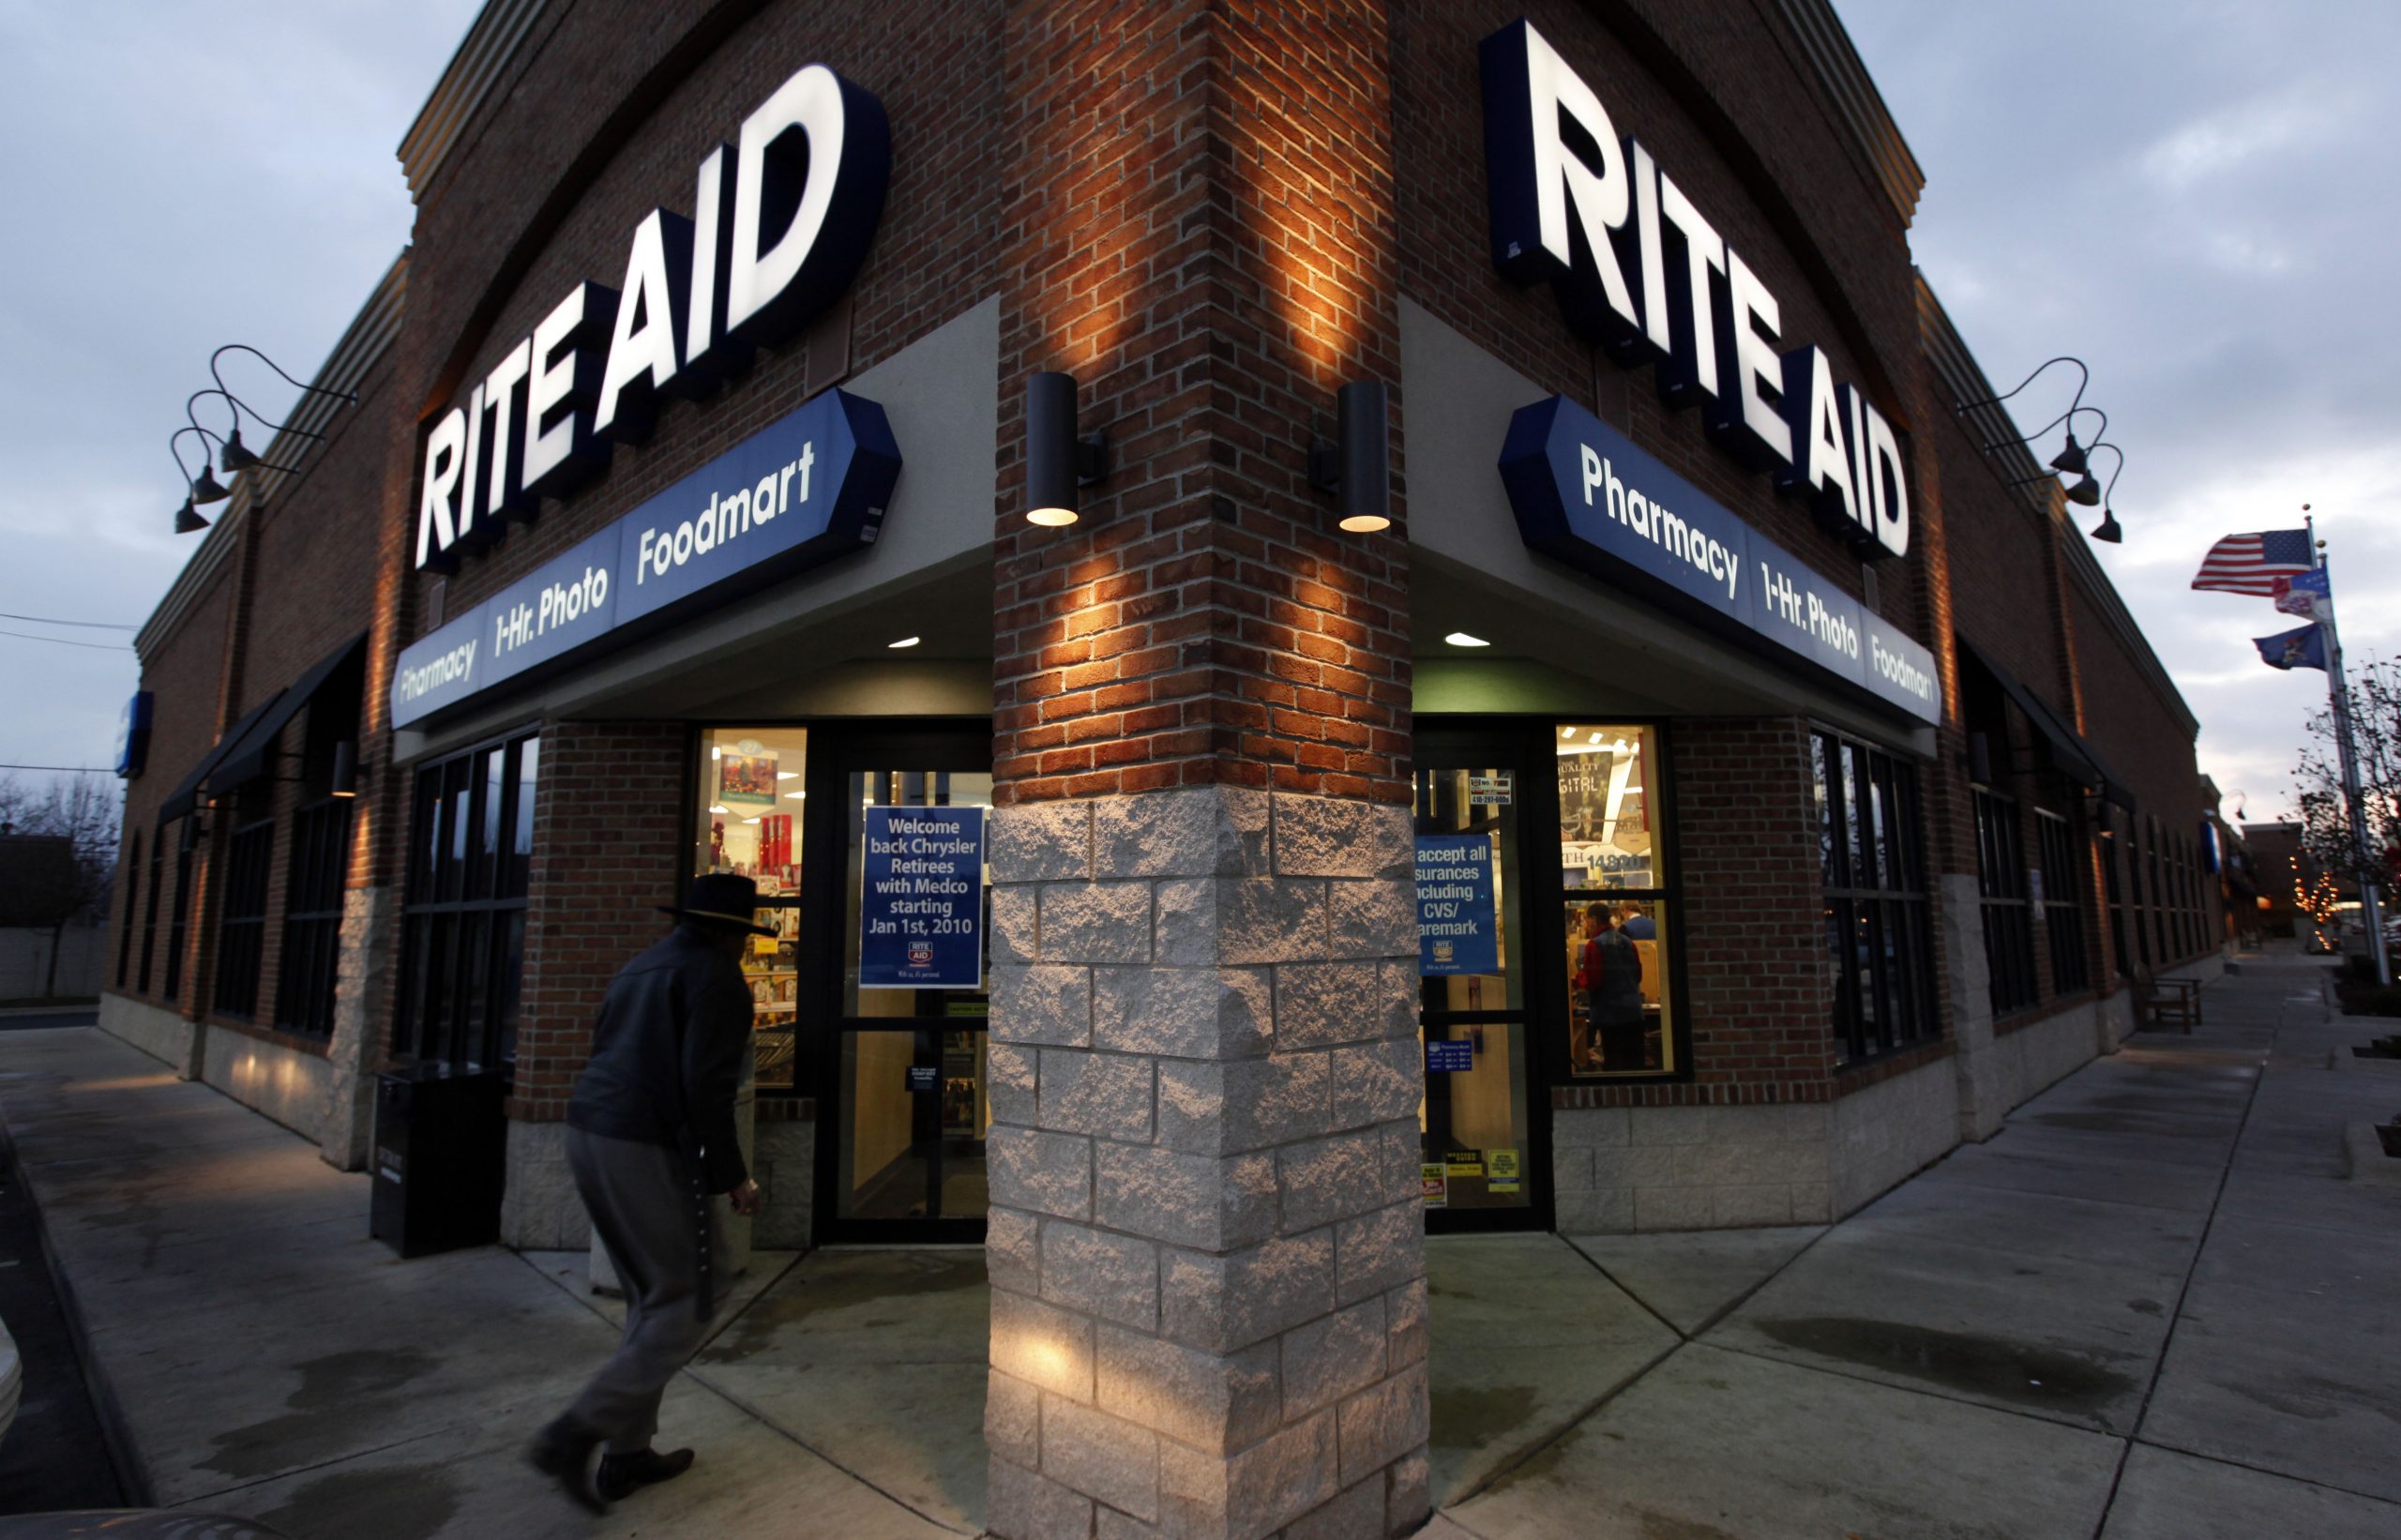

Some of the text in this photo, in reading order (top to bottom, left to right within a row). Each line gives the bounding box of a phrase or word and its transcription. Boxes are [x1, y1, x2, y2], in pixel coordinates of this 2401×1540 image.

[1526, 21, 1910, 557] RITE AID
[415, 63, 844, 569] RITE AID
[400, 441, 814, 703] Pharmacy 1-Hr. Photo Foodmart
[1580, 444, 1935, 702] Pharmacy 1-Hr. Photo Foodmart
[888, 819, 960, 834] Welcome
[870, 838, 976, 857] back Chrysler
[1417, 845, 1487, 865] accept all
[891, 858, 955, 873] Retirees
[1414, 867, 1479, 882] surances
[876, 878, 968, 894] with Medco
[890, 898, 952, 917] starting
[1424, 902, 1459, 918] CVS/
[869, 918, 973, 936] Jan 1st, 2010
[913, 951, 929, 959] AID
